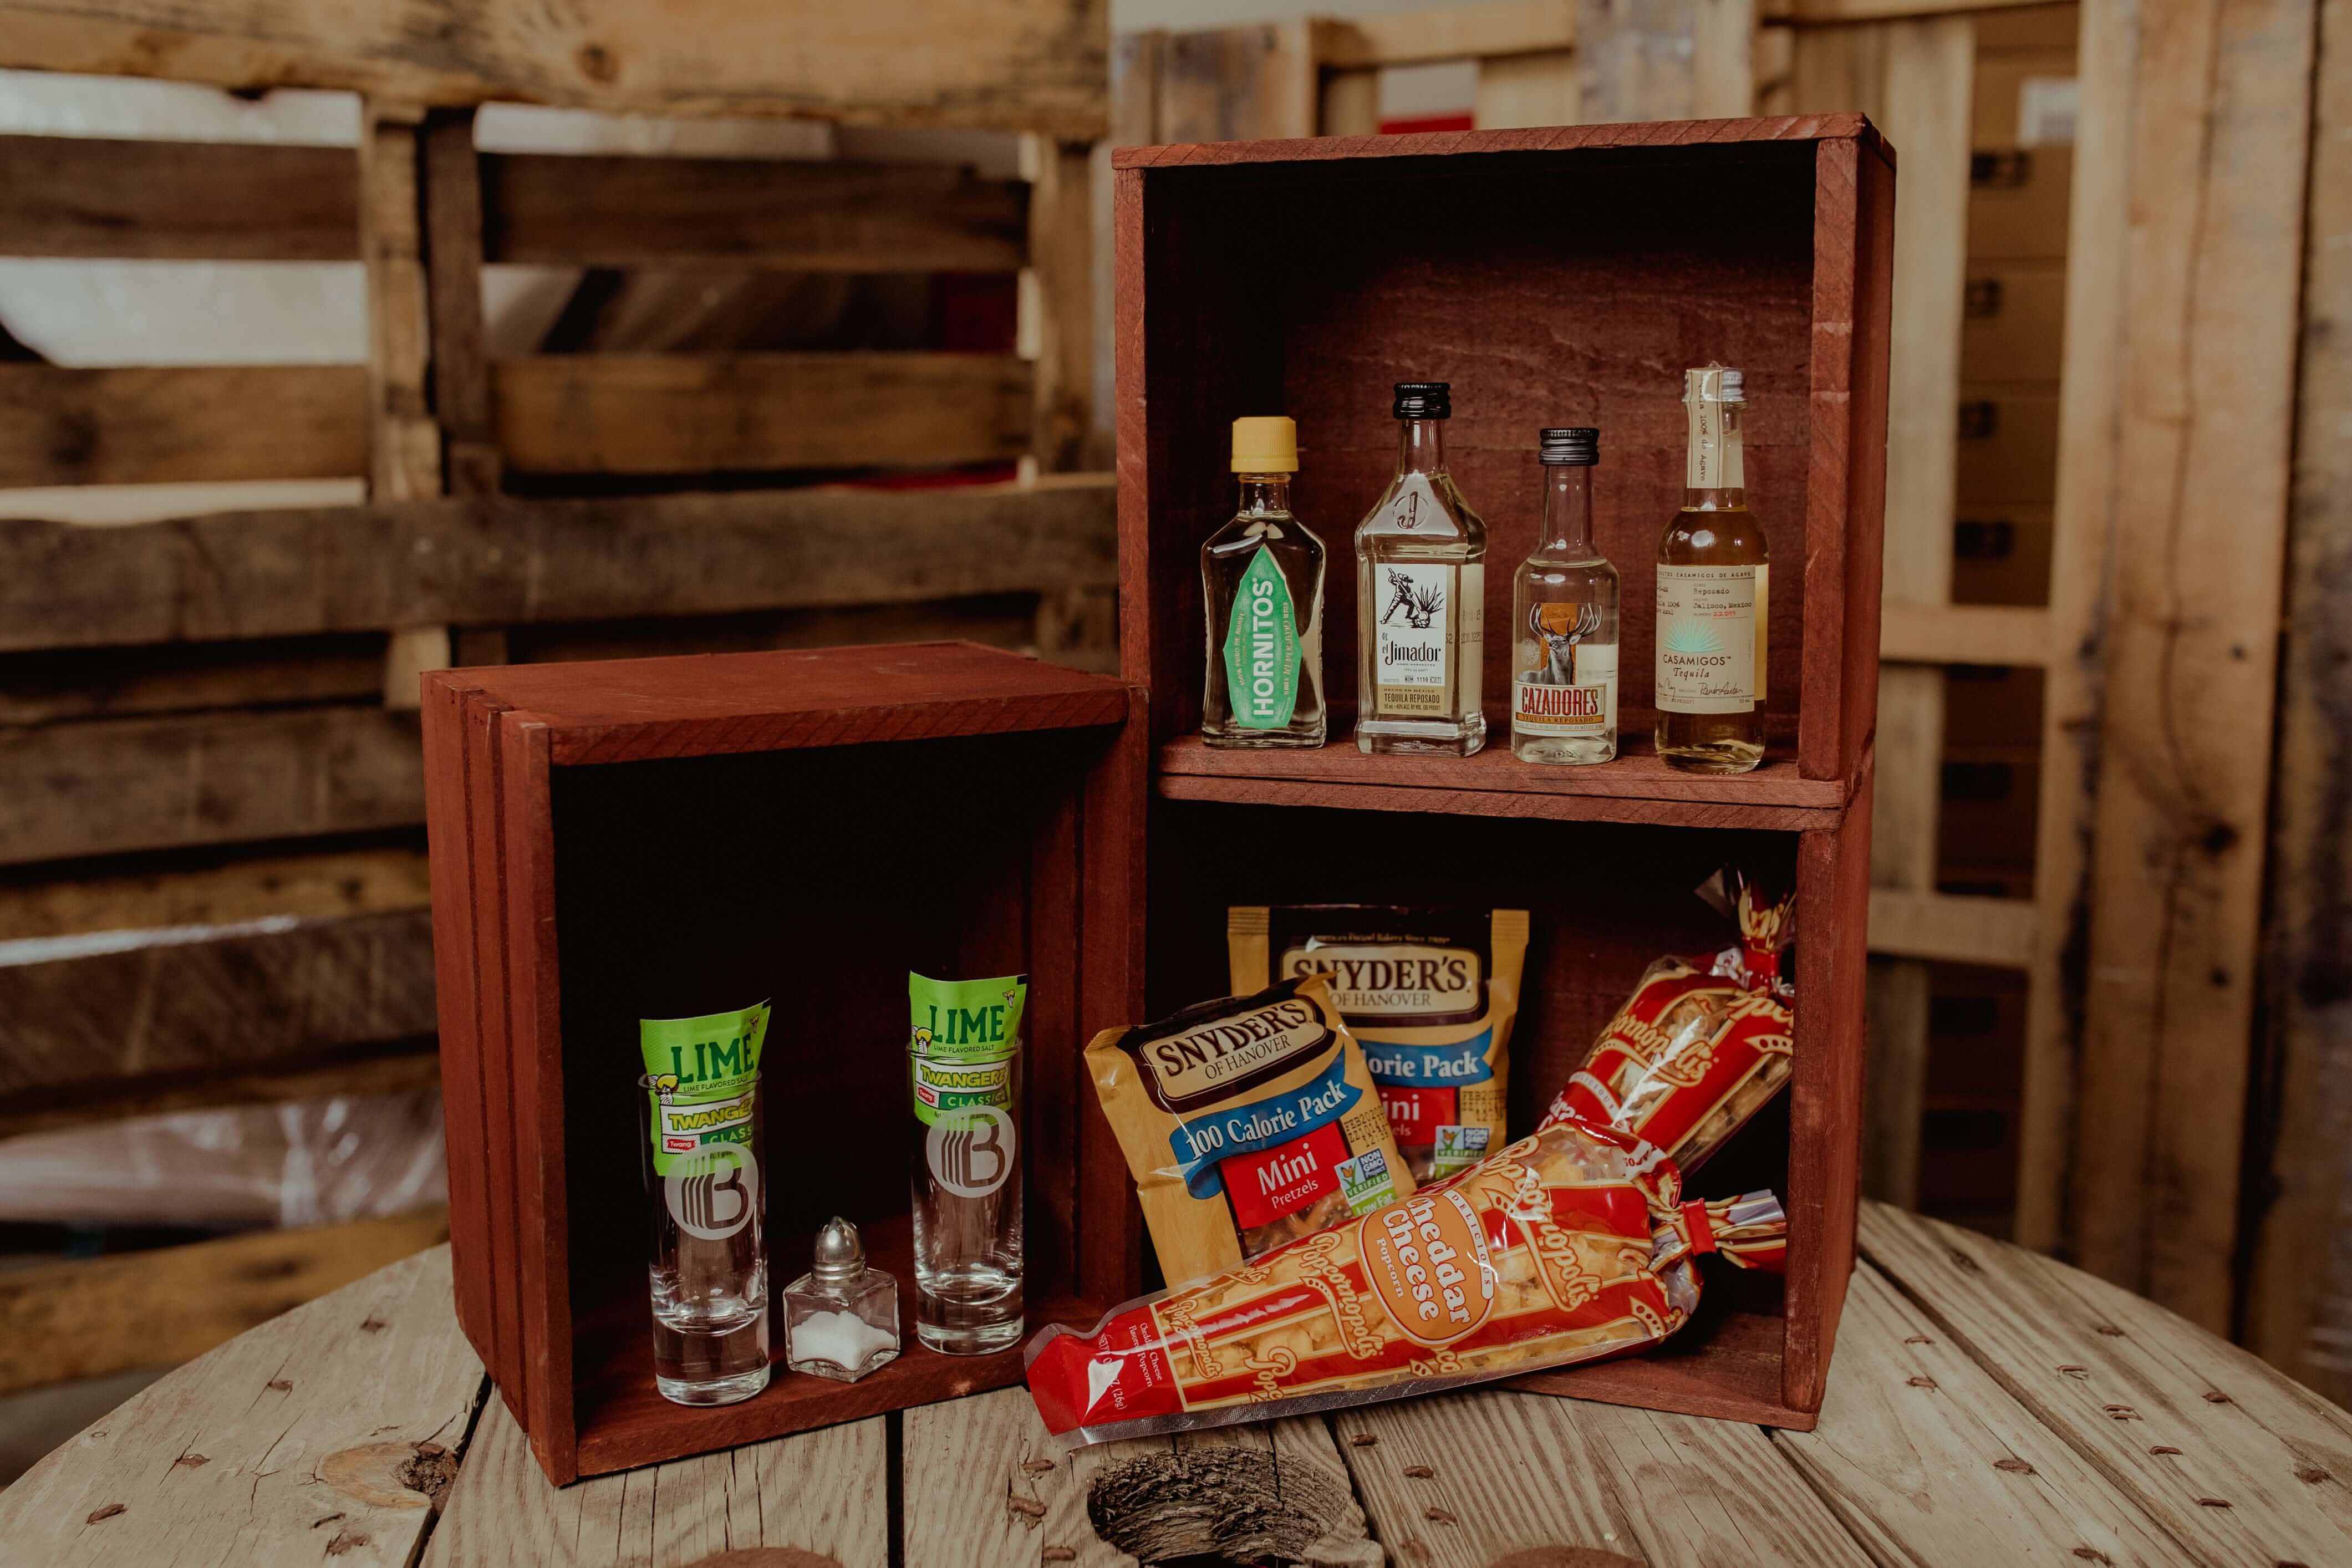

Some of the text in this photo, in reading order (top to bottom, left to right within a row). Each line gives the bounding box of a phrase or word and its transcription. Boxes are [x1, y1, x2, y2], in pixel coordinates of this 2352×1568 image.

[1699, 414, 1708, 435] 100%
[1699, 454, 1707, 481] Agave
[1253, 580, 1274, 715] HORNITOS
[1282, 620, 1293, 675] REPOSADO
[1384, 640, 1442, 666] Jimador
[1673, 667, 1710, 681] Tequila
[1384, 693, 1440, 704] TEQUILA REPOSADO
[1521, 686, 1598, 716] CAZADORES
[1294, 956, 1468, 992] SNYDER'S
[1331, 992, 1433, 1006] OF HANOVER
[929, 1004, 1005, 1045] LIME
[934, 1044, 947, 1052] LIME
[949, 1045, 981, 1053] FLAVORED
[1155, 1002, 1309, 1077] SNYDER'S
[671, 1032, 755, 1084] LIME
[1204, 1034, 1292, 1080] OF HANOVER
[1362, 1050, 1479, 1078] orie Pack
[701, 1080, 734, 1091] FLAVORED
[734, 1075, 749, 1085] SALT
[920, 1064, 1008, 1088] TWANGERZ
[1185, 1080, 1348, 1160] 100 Calorie Pack
[1382, 1092, 1421, 1121] ini
[669, 1141, 692, 1149] Twang
[1360, 1149, 1381, 1165] NON
[1256, 1142, 1319, 1197] Mini
[1363, 1158, 1384, 1172] GMO
[1271, 1178, 1319, 1209] Pretzels
[1347, 1173, 1389, 1197] VERIFIED
[1356, 1192, 1393, 1216] Low Fat
[1452, 1194, 1491, 1285] DELICIOUS
[1376, 1237, 1405, 1299] Popcorn
[1382, 1208, 1441, 1322] Cheese
[1404, 1197, 1473, 1324] Cheddar
[1284, 1231, 1386, 1360] Popcornopolis
[1137, 1352, 1153, 1388] Popcorn
[1149, 1352, 1163, 1381] Cheese
[1111, 1388, 1128, 1411] (26g)
